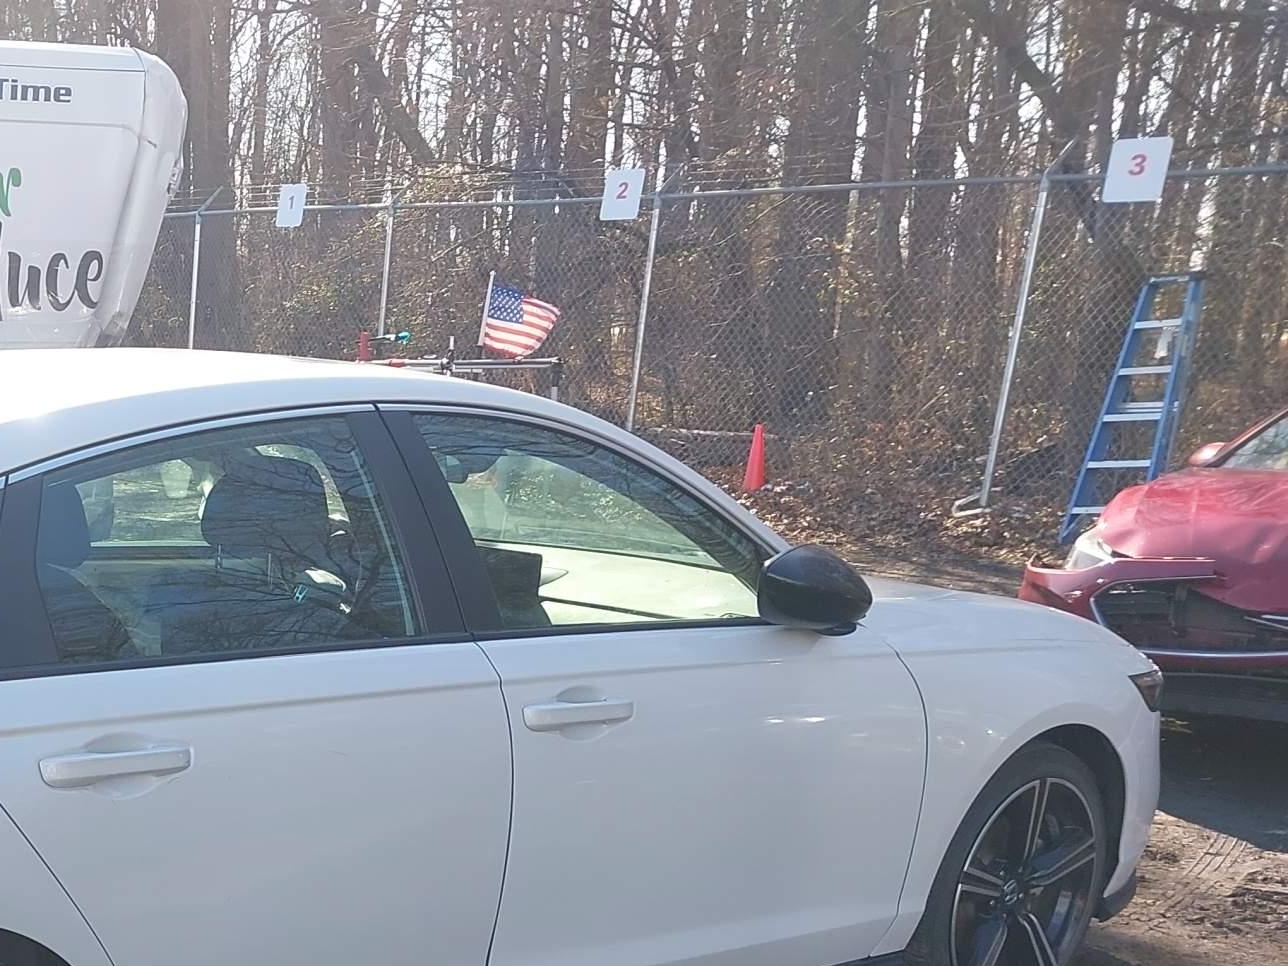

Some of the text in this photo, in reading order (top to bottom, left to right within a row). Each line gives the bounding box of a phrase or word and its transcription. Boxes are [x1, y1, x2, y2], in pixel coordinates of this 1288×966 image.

[1128, 153, 1147, 176] 3
[615, 181, 630, 200] 2
[288, 195, 296, 210] 1
